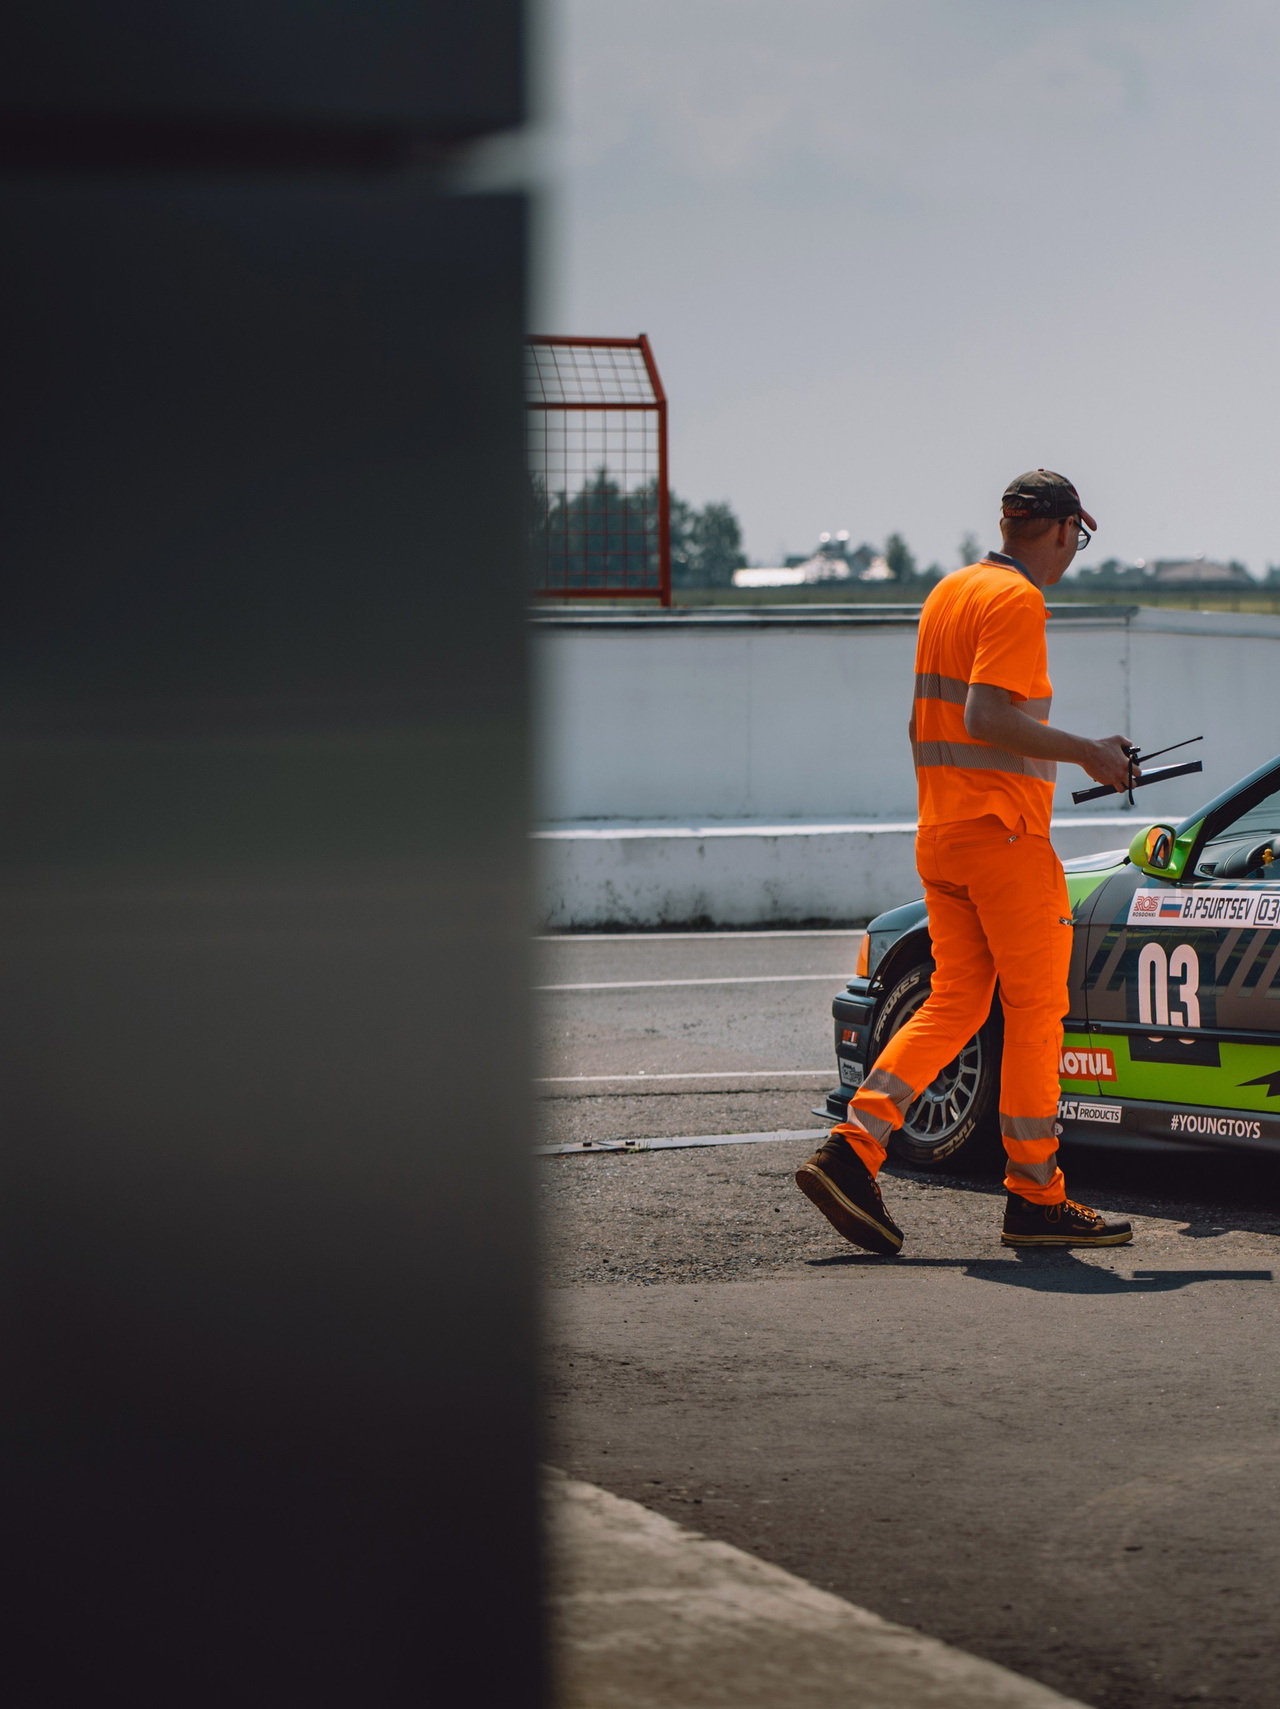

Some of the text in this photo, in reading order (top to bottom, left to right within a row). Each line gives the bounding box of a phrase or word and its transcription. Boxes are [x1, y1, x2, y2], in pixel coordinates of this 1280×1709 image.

[1133, 896, 1160, 911] ROS
[1182, 896, 1280, 921] B.PSURTSEV 03
[1138, 942, 1201, 1045] 03
[1080, 1108, 1120, 1121] PRODUCTS
[1171, 1114, 1261, 1139] #YOUNGTOYS
